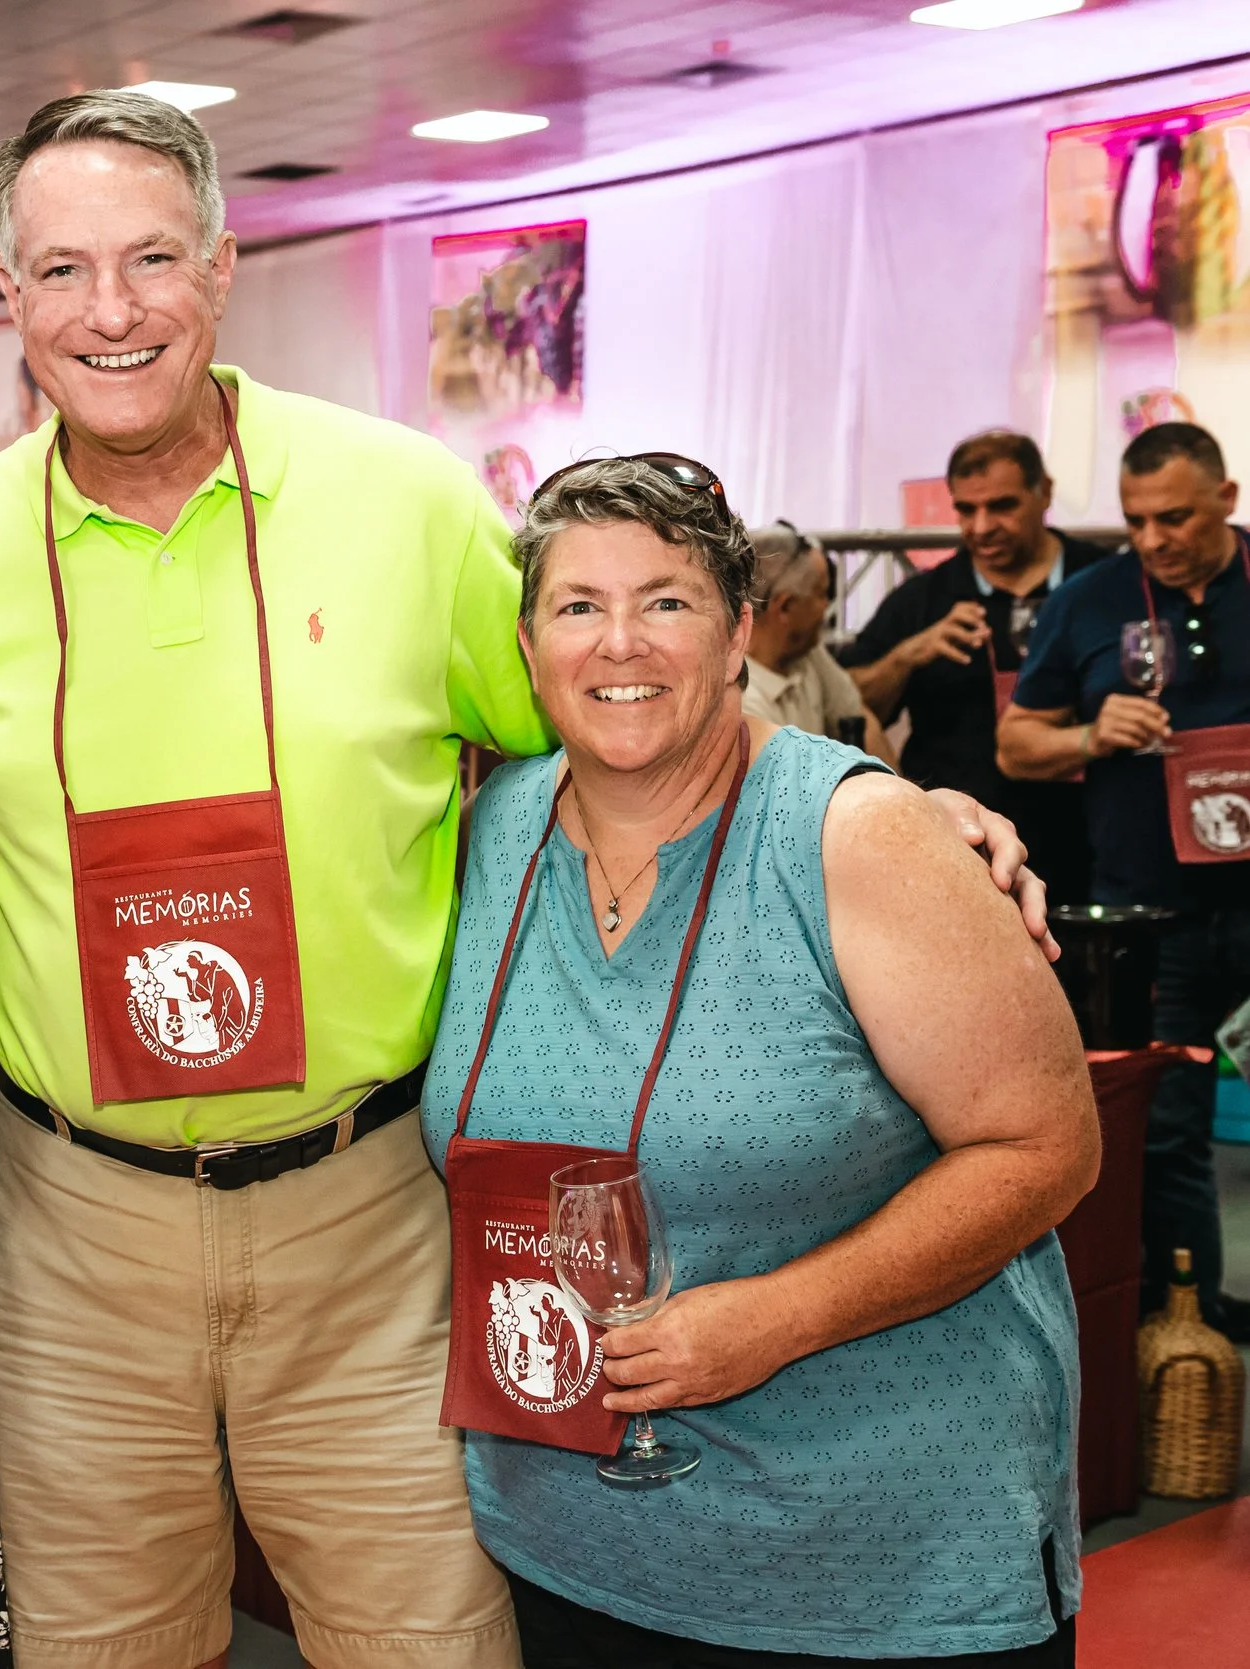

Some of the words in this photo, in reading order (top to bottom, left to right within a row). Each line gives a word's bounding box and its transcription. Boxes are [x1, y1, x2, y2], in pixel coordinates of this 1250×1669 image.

[114, 889, 173, 904] RESTAURANTE
[115, 887, 251, 927] MEMÓRIAS
[182, 909, 253, 926] MEMORIES
[126, 997, 161, 1058] CONFRARIA
[161, 1053, 178, 1065] DO
[180, 1049, 232, 1068] BACCHUS
[231, 1040, 246, 1056] DE
[246, 976, 265, 1042] ALBUFEIRA
[485, 1220, 535, 1231] RESTAURANTE
[485, 1321, 506, 1390] CONFRARIA
[505, 1386, 517, 1401] DO
[518, 1398, 564, 1414] BACCHUS
[563, 1394, 579, 1409] DE
